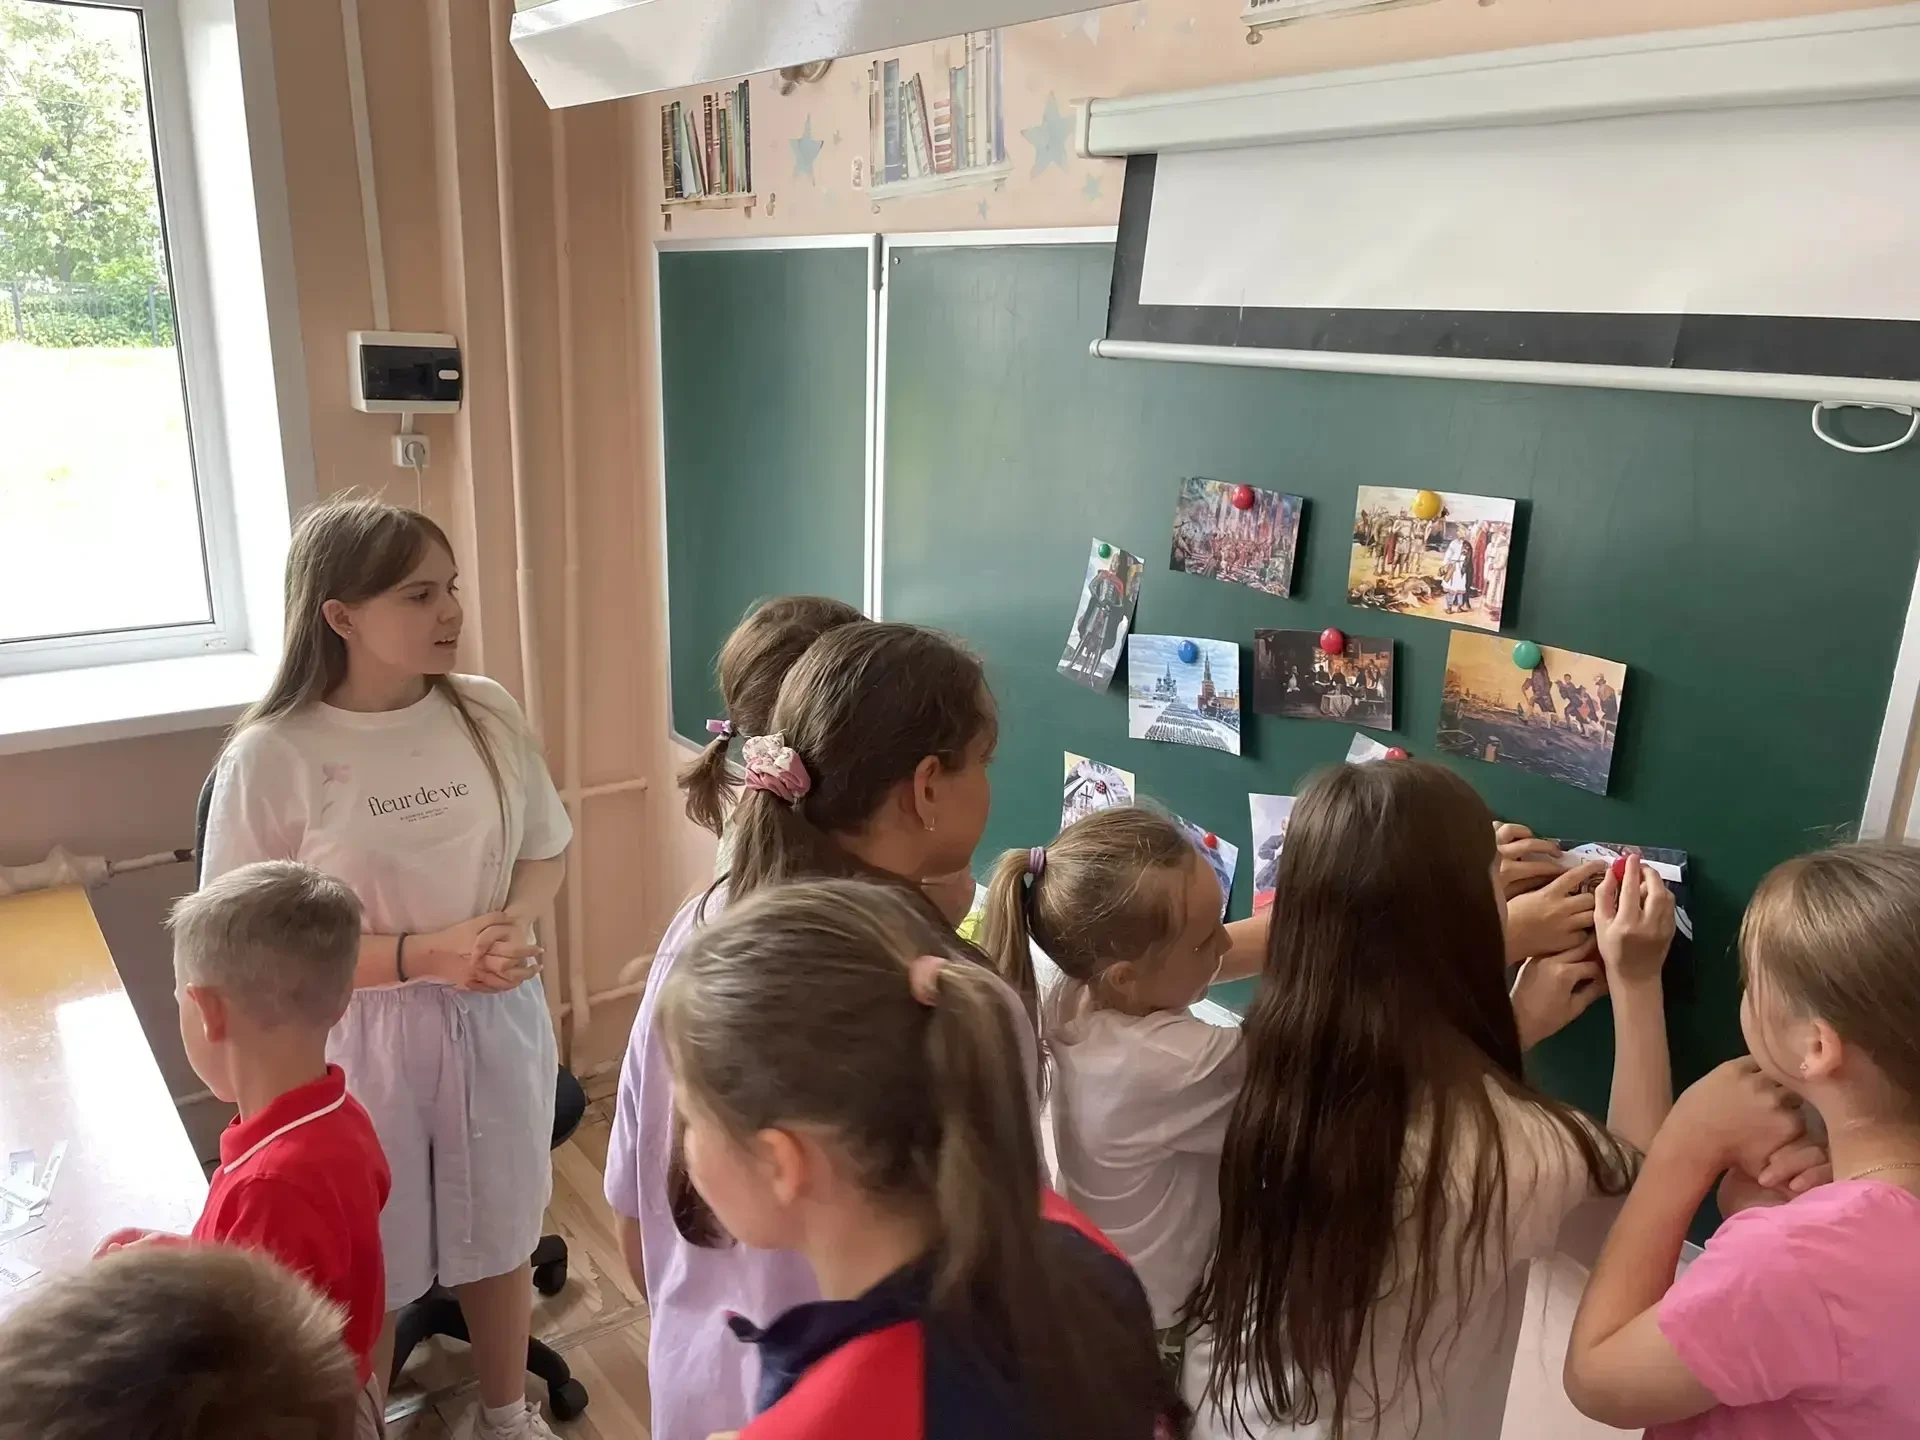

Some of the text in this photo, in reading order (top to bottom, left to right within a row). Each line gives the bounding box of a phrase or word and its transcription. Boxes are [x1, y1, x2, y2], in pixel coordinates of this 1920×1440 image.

[368, 795, 412, 816] fleur
[415, 786, 440, 805] de
[440, 781, 469, 799] vie
